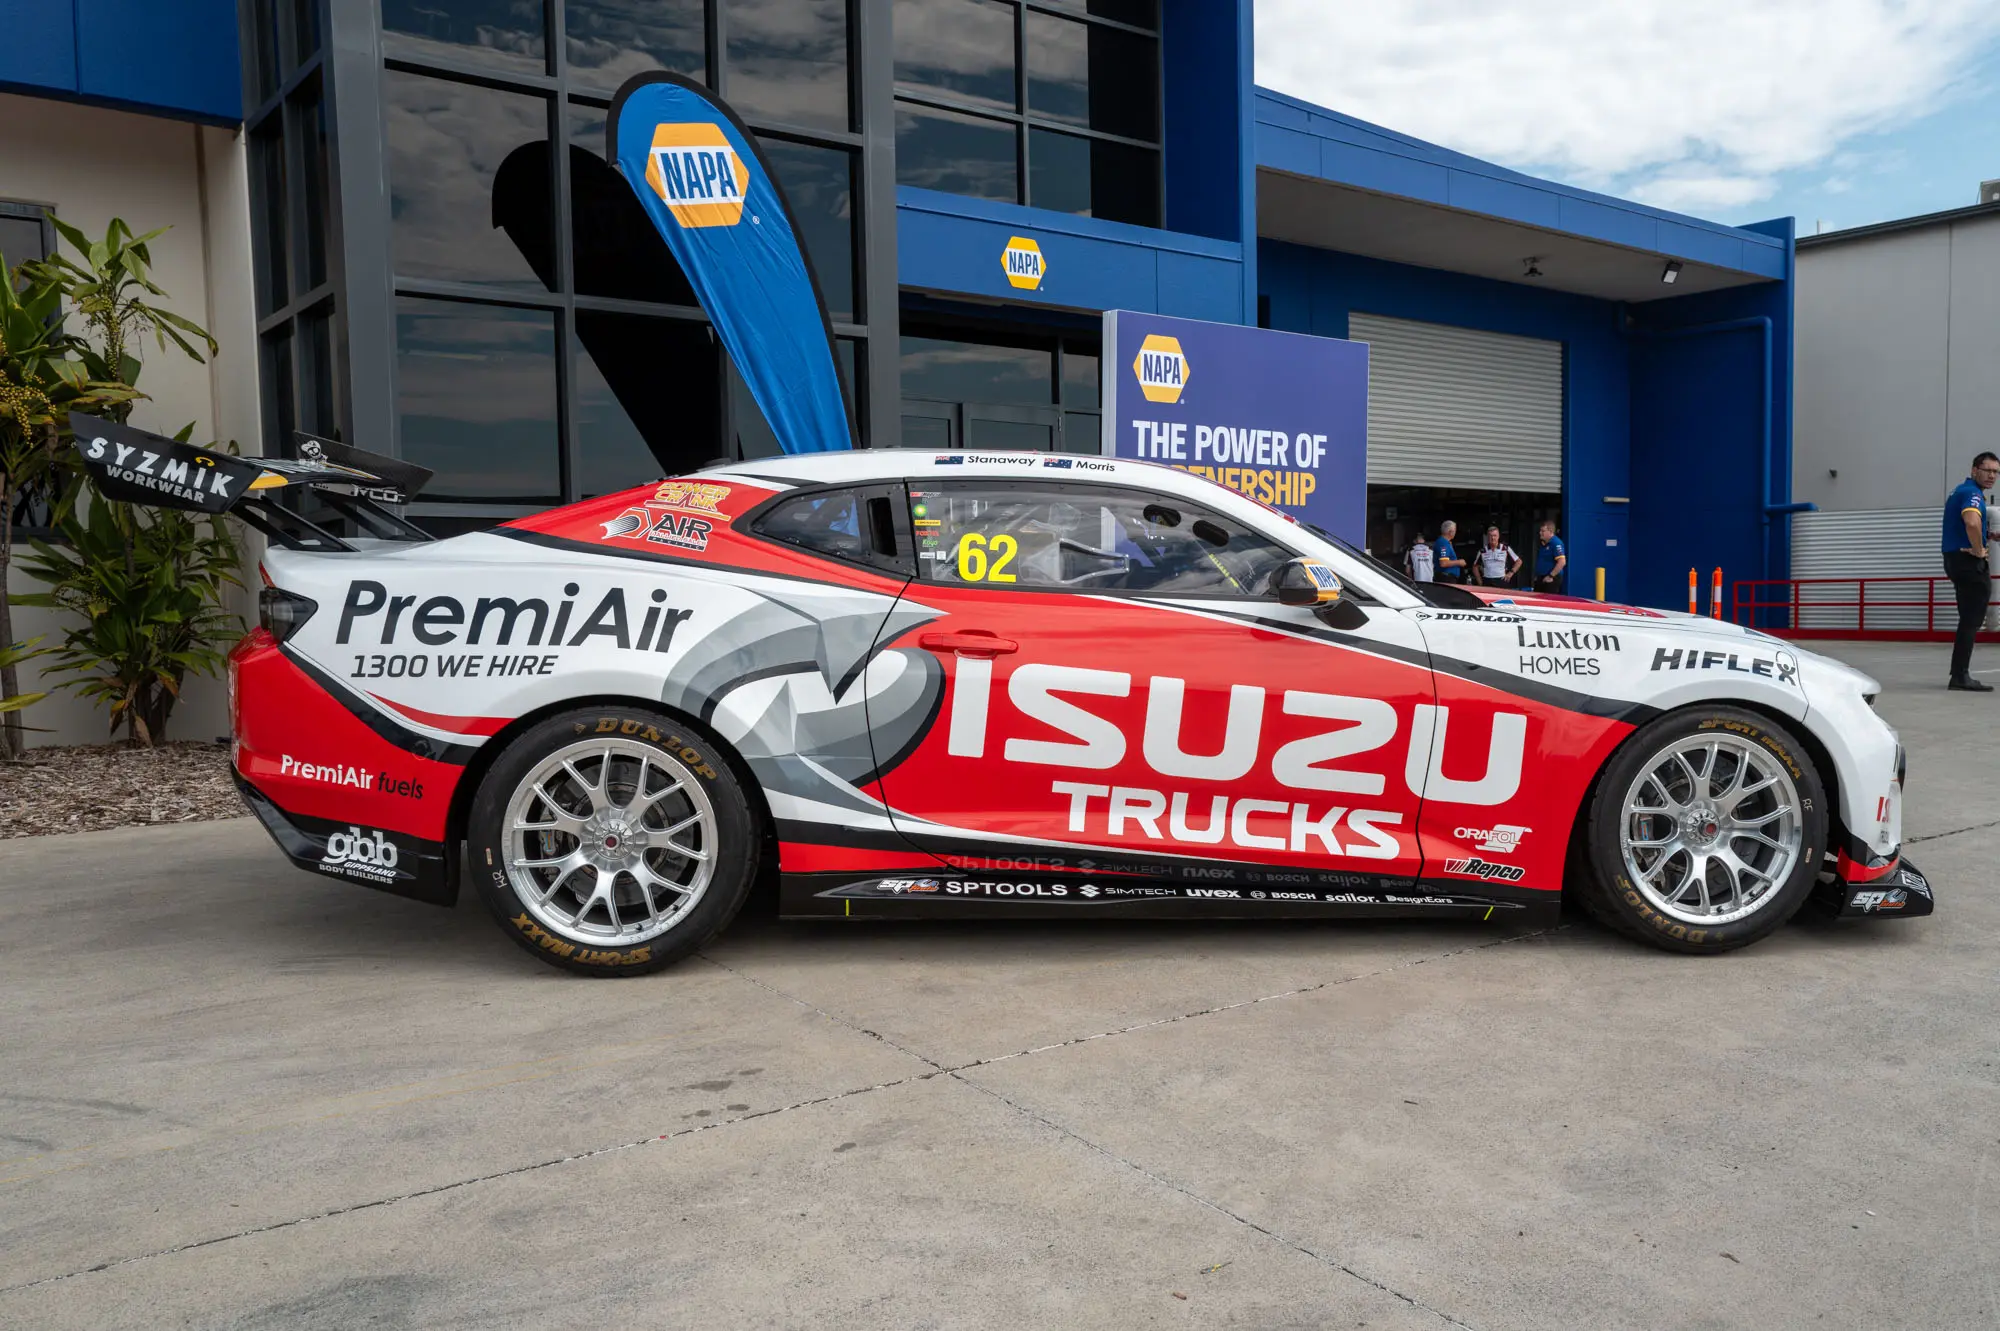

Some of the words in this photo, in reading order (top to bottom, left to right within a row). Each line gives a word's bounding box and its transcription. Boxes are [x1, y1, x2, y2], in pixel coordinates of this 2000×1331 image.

[660, 151, 738, 199] NAPA
[1008, 251, 1040, 275] NAPA
[1143, 353, 1181, 385] NAPA
[1132, 420, 1187, 460] THE
[1195, 424, 1289, 466] POWER
[1295, 433, 1328, 468] OF
[87, 437, 235, 499] SYZMIK
[967, 455, 1036, 467] Stanaway
[1076, 461, 1116, 472] Morris
[106, 464, 205, 504] WORKWEAR
[656, 482, 732, 500] POWER
[651, 514, 713, 541] AIR
[958, 533, 1018, 583] 62
[335, 580, 694, 654] PremiAir
[1435, 613, 1528, 624] DUNLOP
[1517, 625, 1621, 652] Luxton
[350, 655, 428, 678] 1300
[437, 655, 484, 678] WE
[486, 654, 559, 677] HIRE
[1519, 655, 1601, 675] HOMES
[948, 656, 1527, 806] ISUZU
[595, 717, 718, 780] DUNLOP
[280, 754, 374, 790] PremiAir
[377, 771, 424, 800] fuels
[1051, 780, 1404, 861] TRUCKS
[322, 826, 398, 868] gbb
[1453, 827, 1521, 845] ORAFOL
[319, 863, 345, 875] BODY
[345, 868, 394, 884] BUILDERS
[343, 861, 397, 878] GIPPSLAND
[1463, 859, 1524, 879] Repco
[945, 881, 1068, 896] SPTOOLS
[1104, 887, 1177, 895] SIMTECH
[1186, 888, 1241, 899] uvex
[1271, 891, 1316, 900] BOSCH
[510, 912, 576, 965] MAXX
